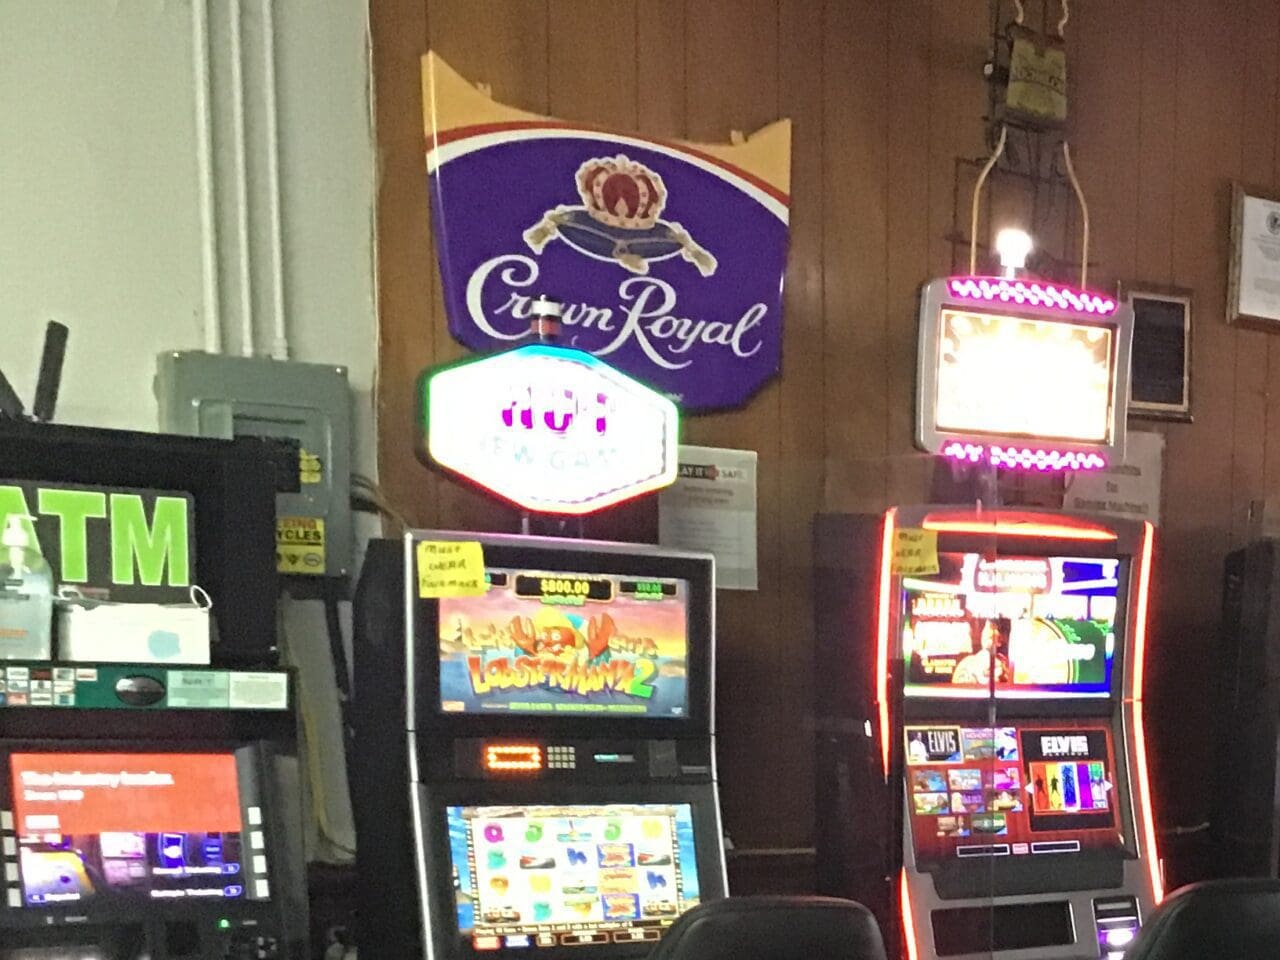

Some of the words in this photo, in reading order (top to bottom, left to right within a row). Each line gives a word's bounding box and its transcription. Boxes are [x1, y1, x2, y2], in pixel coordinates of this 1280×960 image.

[466, 254, 616, 340] Crwn
[590, 277, 767, 369] Royal
[928, 731, 956, 753] ELVIS
[1040, 735, 1089, 753] ELVIS
